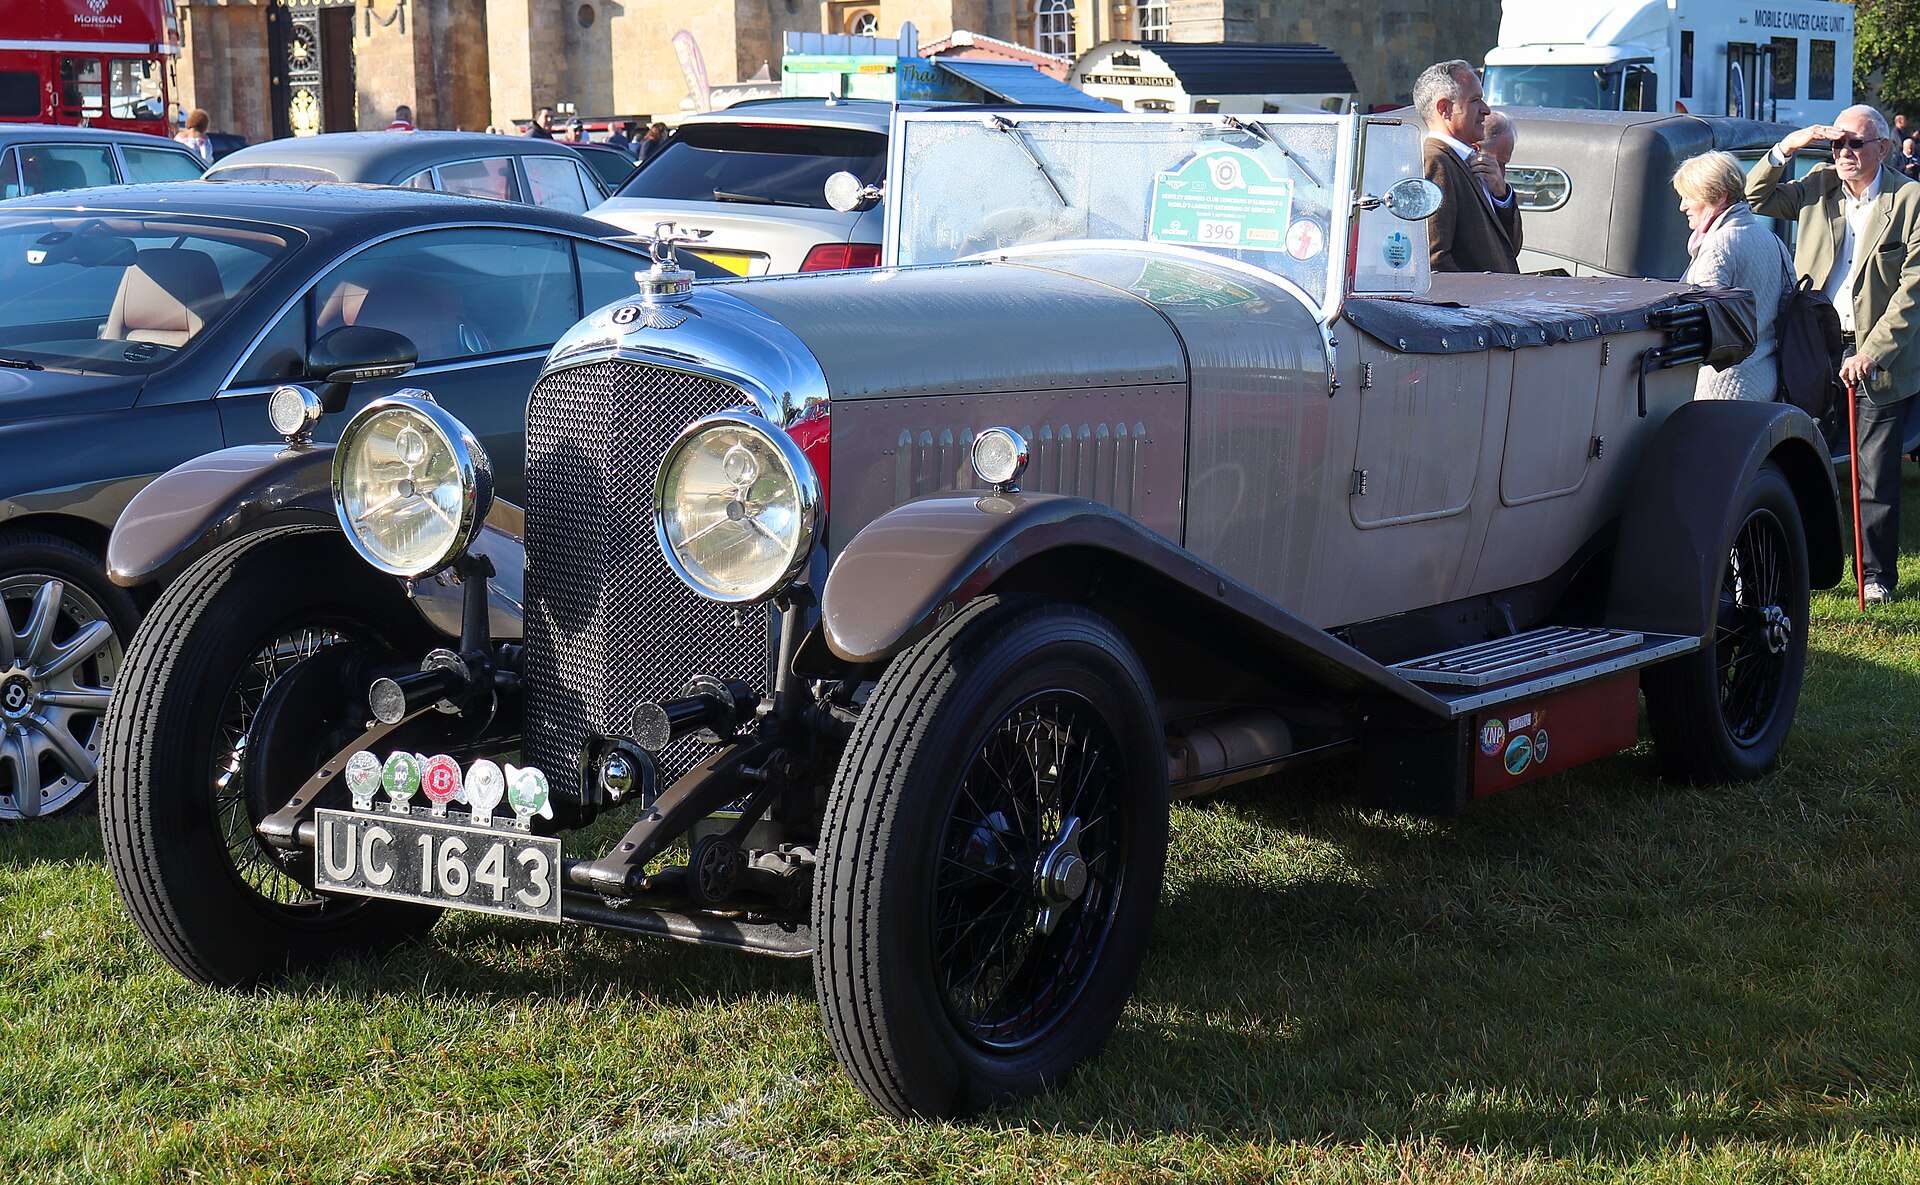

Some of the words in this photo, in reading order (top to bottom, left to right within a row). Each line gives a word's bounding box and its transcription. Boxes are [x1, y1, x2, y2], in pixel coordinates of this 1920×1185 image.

[74, 14, 122, 24] MORGAN
[1755, 9, 1781, 28] MOBILE
[1783, 12, 1810, 31] CANCER
[1811, 15, 1828, 32] CARE
[1830, 16, 1845, 33] UNIT
[1100, 76, 1130, 84] CREAM
[1134, 77, 1173, 86] SUNDAES
[1204, 224, 1234, 240] 396
[1484, 727, 1503, 745] YNP
[323, 820, 395, 886] UC
[418, 834, 552, 908] 1643
